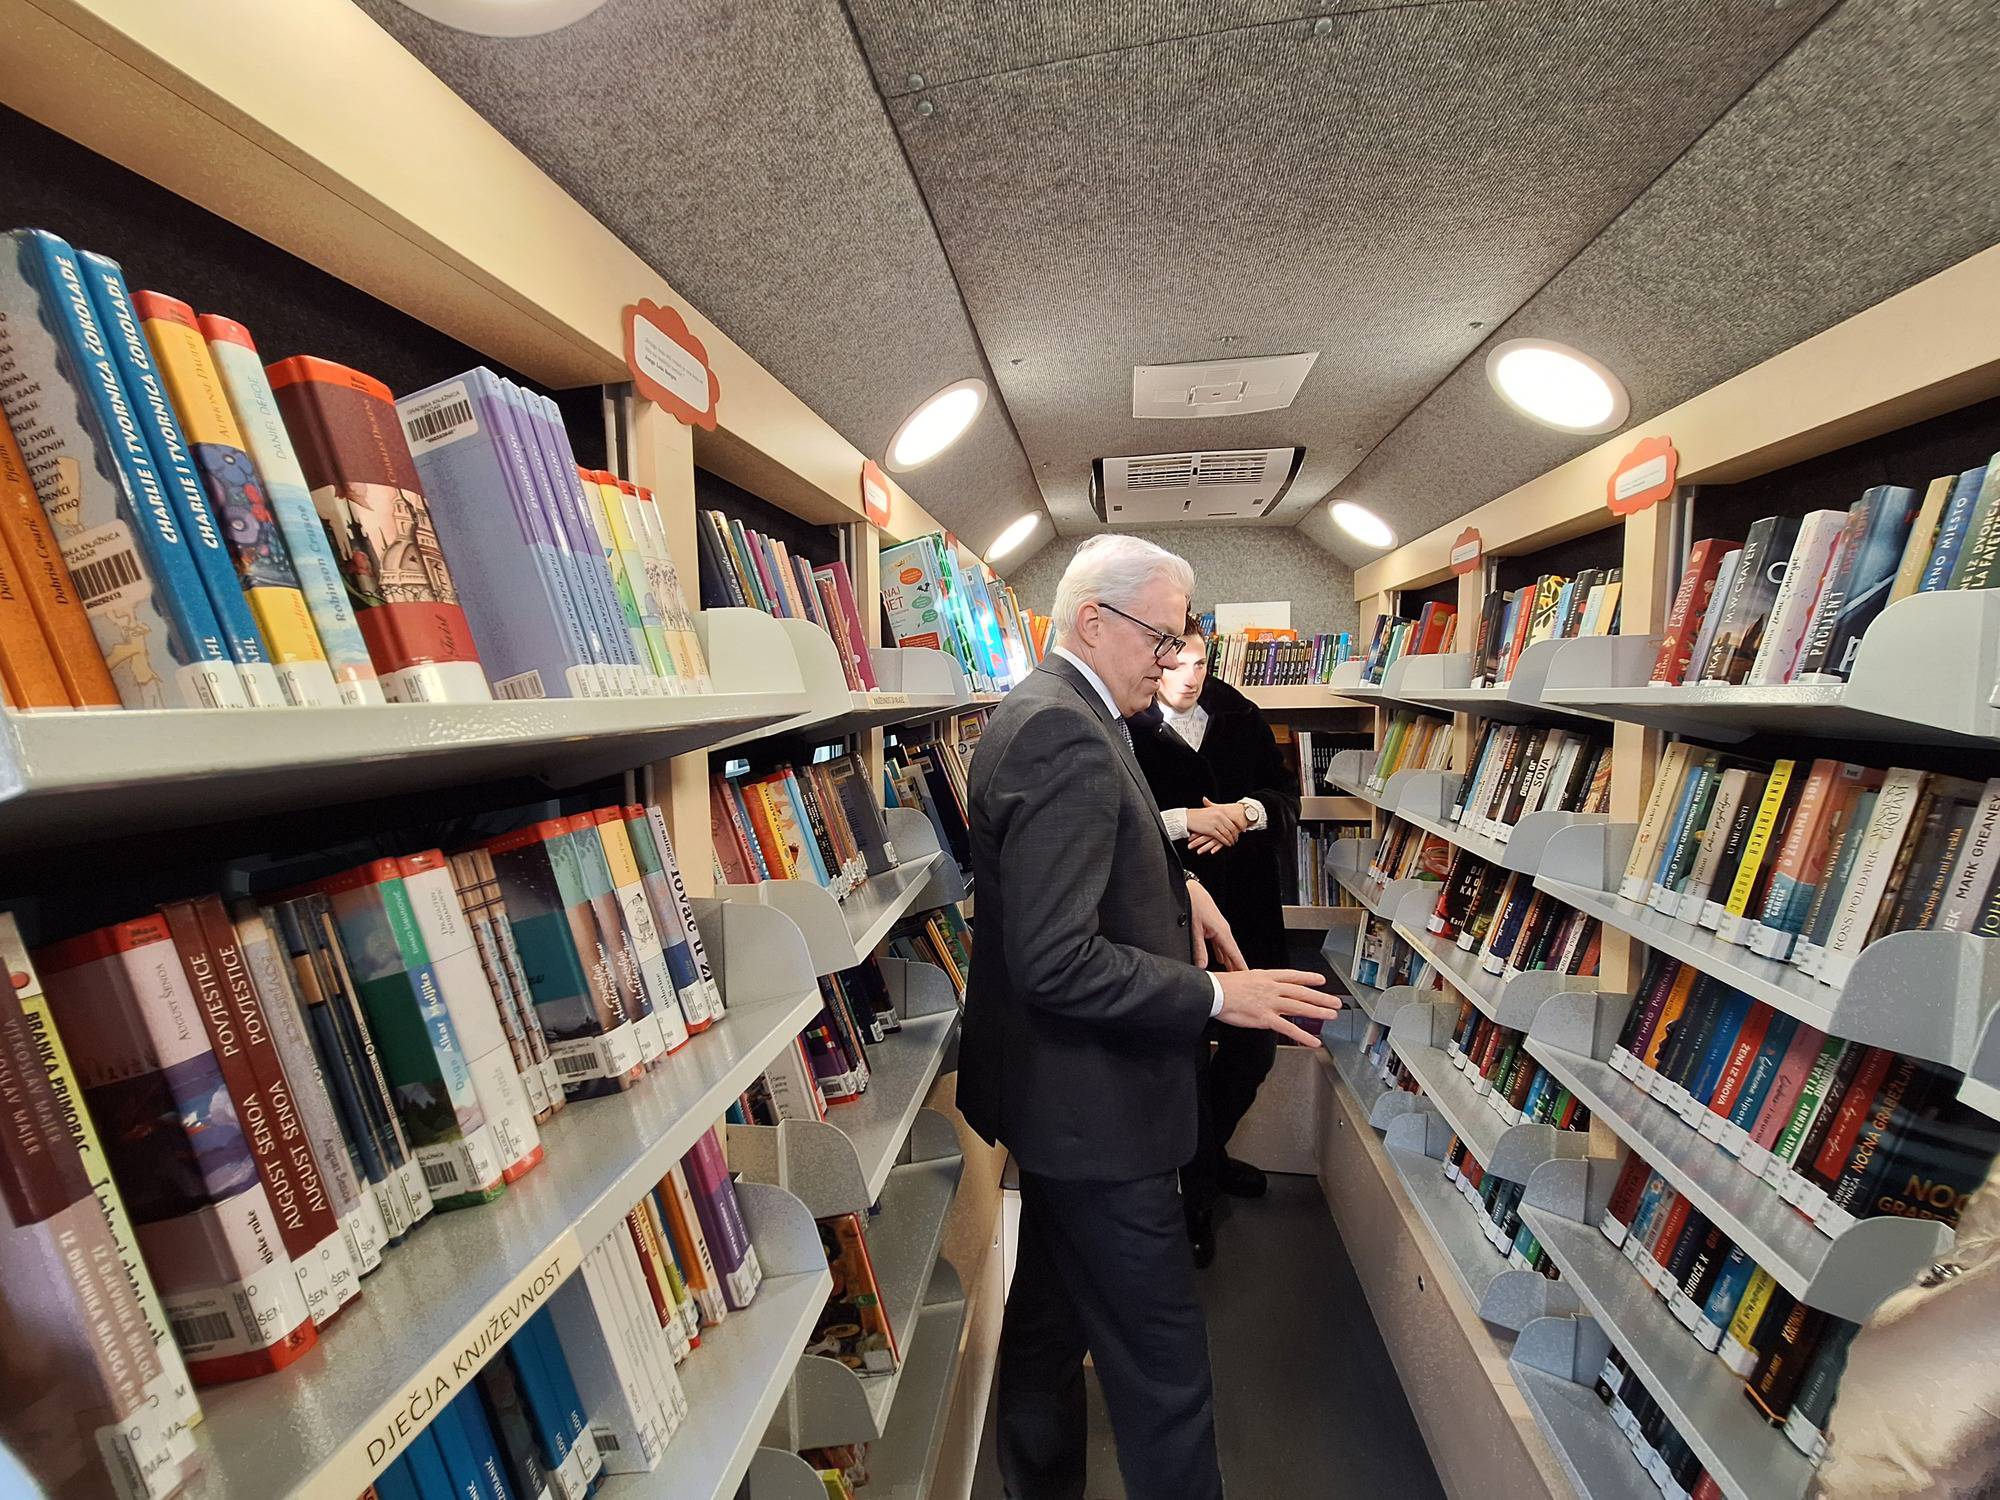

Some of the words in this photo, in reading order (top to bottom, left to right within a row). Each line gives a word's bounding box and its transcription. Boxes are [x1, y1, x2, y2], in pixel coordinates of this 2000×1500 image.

[55, 255, 106, 357] ČOKOLADE
[104, 274, 150, 371] ČOKOLADE
[96, 360, 144, 453] TVORNICA
[141, 375, 186, 462] TVORNICA
[137, 467, 178, 543] CHARLIE
[181, 478, 218, 548] CHARLIE
[318, 557, 347, 622] Robinson
[1735, 541, 1759, 594] CRAVEN
[1972, 569, 1989, 588] LA
[1809, 592, 1844, 657] PACIJENT
[1533, 757, 1551, 788] SOVA
[1766, 770, 1785, 803] TANA
[1803, 773, 1821, 802] SOLI
[1729, 829, 1742, 847] IME
[1733, 803, 1752, 830] ČASTI
[1748, 808, 1772, 856] FRENCH
[1866, 782, 1900, 839] WINSTON
[1876, 783, 1912, 842] GRAHAM
[1955, 859, 1979, 899] MARK
[1971, 793, 2000, 858] GREANEY
[665, 868, 701, 933] lovac
[691, 938, 706, 956] u
[1831, 915, 1854, 951] ROSS
[1844, 846, 1882, 913] POLDARK
[186, 951, 243, 1057] POVJESTICE
[217, 943, 267, 1045] POVJESTICE
[418, 971, 441, 1018] Muljika
[1639, 1010, 1655, 1033] HAIG
[435, 1021, 453, 1054] Alkar
[0, 1018, 47, 1097] VJEKOSLAV
[32, 1098, 64, 1144] MAJER
[24, 1010, 62, 1075] BRANKA
[49, 1075, 93, 1155] PRIMORAC
[1714, 1075, 1737, 1107] SNOVA
[1728, 1065, 1739, 1076] IZ
[13, 1107, 40, 1156] MAJER
[237, 1092, 278, 1156] ŠENOA
[263, 1079, 301, 1141] ŠENOA
[1790, 1102, 1812, 1134] HENRY
[261, 1157, 307, 1231] AUGUST
[287, 1143, 328, 1213] AUGUST
[59, 1229, 76, 1246] IZ
[242, 1208, 263, 1236] ruke
[252, 1234, 275, 1266] njske
[64, 1248, 107, 1319] DNEVNIKA
[307, 1286, 328, 1307] ŠEN
[331, 1270, 351, 1288] ŠEN
[93, 1319, 131, 1379] MALOGA
[94, 1261, 139, 1331] DNEVNIKA
[124, 1330, 159, 1382] MALOG
[366, 1376, 450, 1467] DJEČJA
[452, 1257, 563, 1381] KNJIŽEVNOST
